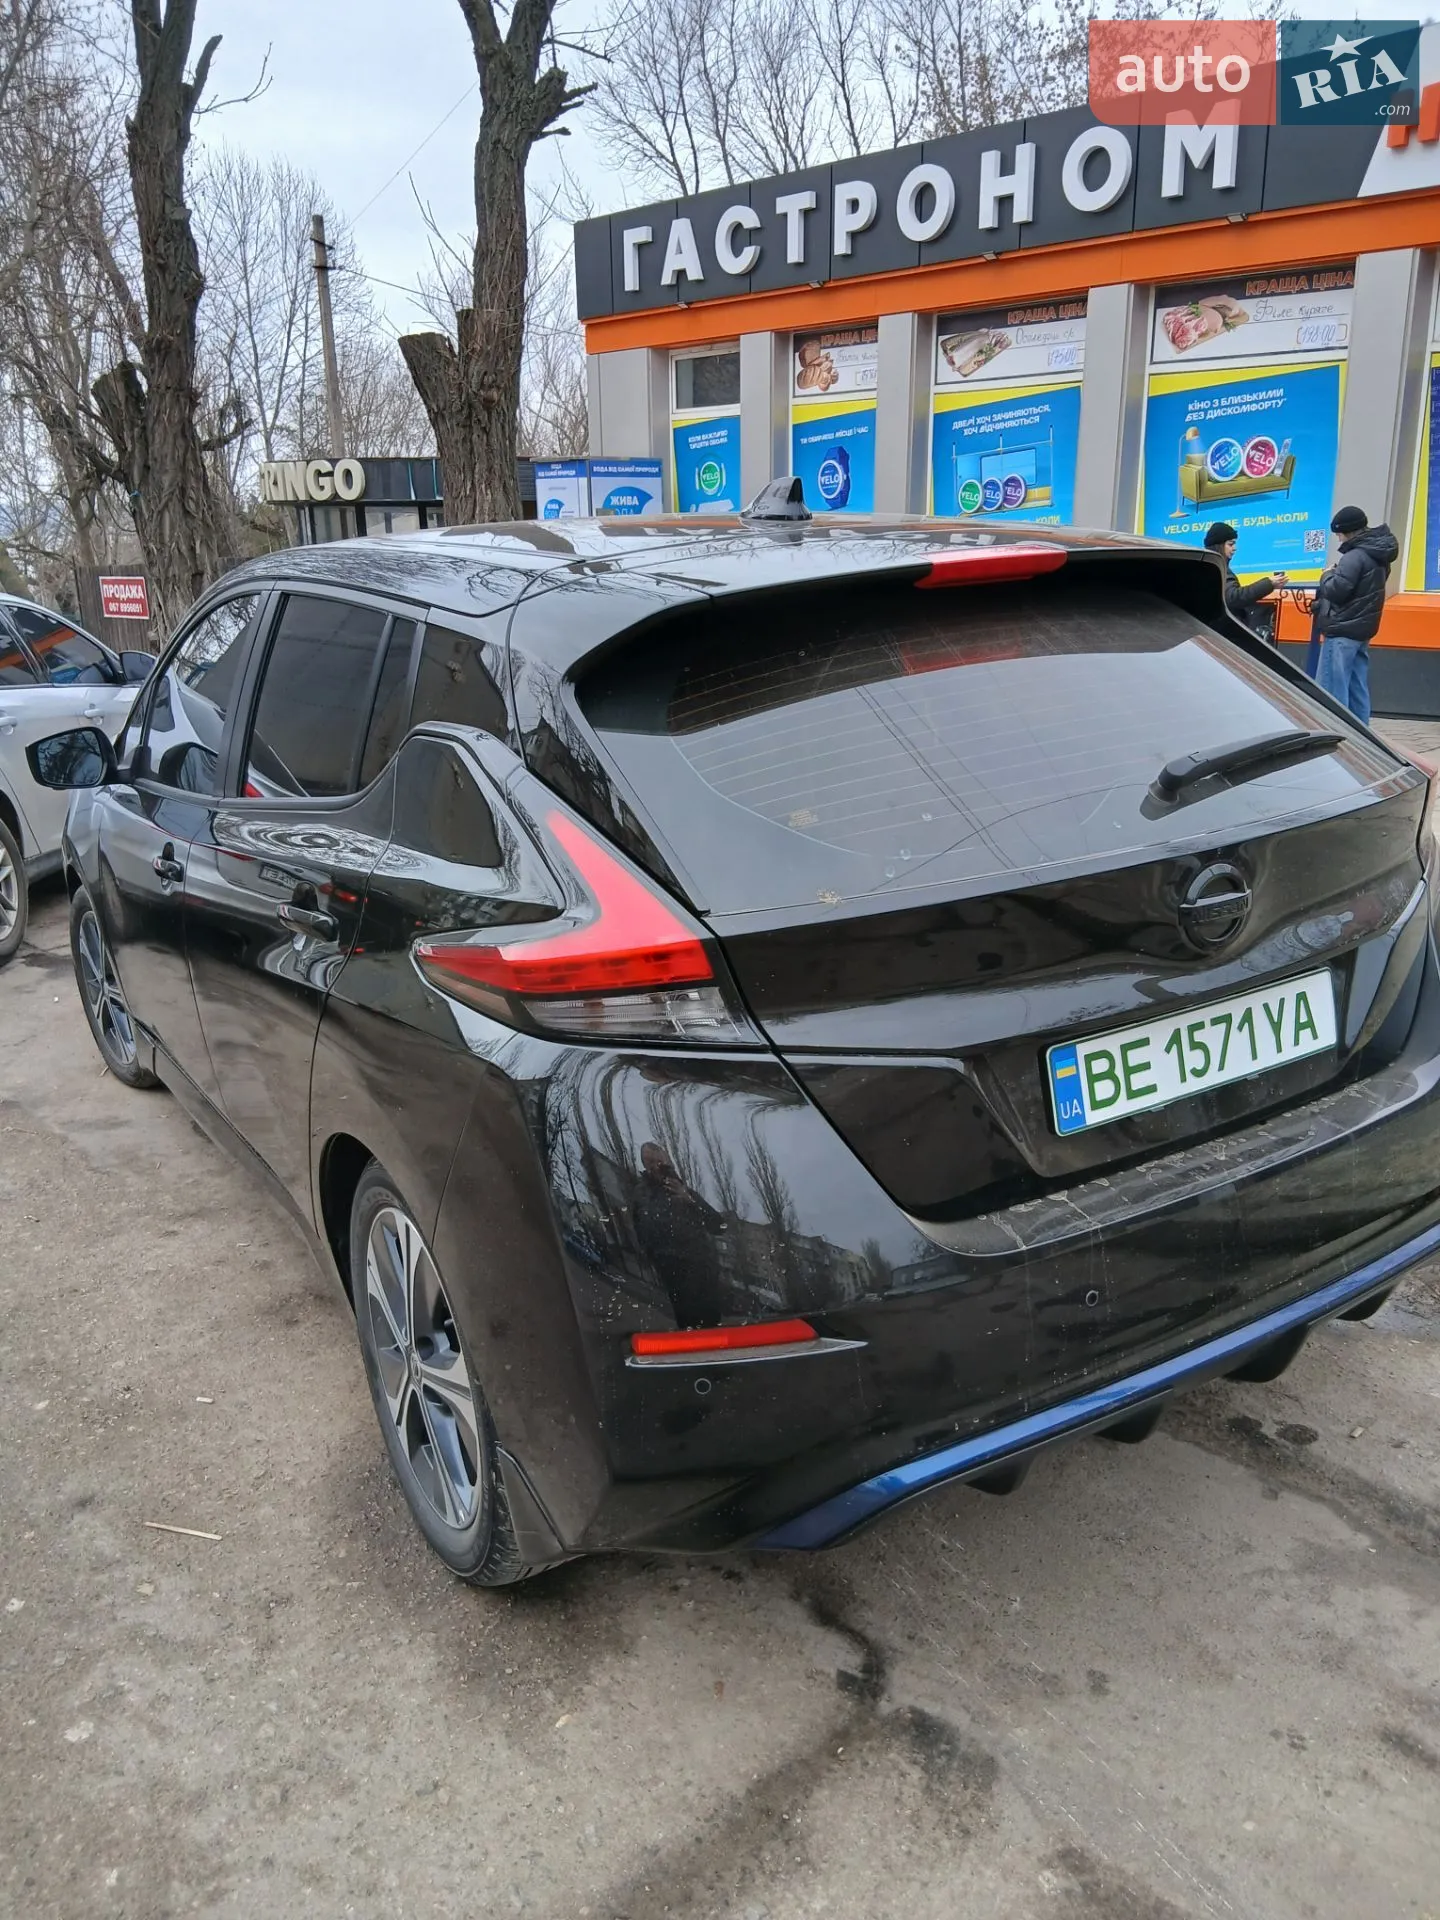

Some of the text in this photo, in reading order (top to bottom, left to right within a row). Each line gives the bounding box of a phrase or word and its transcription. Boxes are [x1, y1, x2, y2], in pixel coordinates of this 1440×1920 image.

[622, 99, 1242, 292] ГАСТРОНОМ
[1245, 271, 1354, 297] КРАЩА ЦІНА
[1220, 388, 1284, 406] БЛИЗЬКИМИ
[1185, 411, 1205, 422] БЕЗ
[1212, 446, 1239, 470] VELO
[1249, 449, 1274, 467] VELO
[610, 495, 639, 506] ЖИВА
[1163, 523, 1190, 535] VELO
[1243, 512, 1309, 527] БУДЬ-КОЛИ
[103, 584, 145, 601] ПРОДАЖА
[1084, 991, 1319, 1112] BE 1571 YA
[1058, 1098, 1083, 1121] UA
